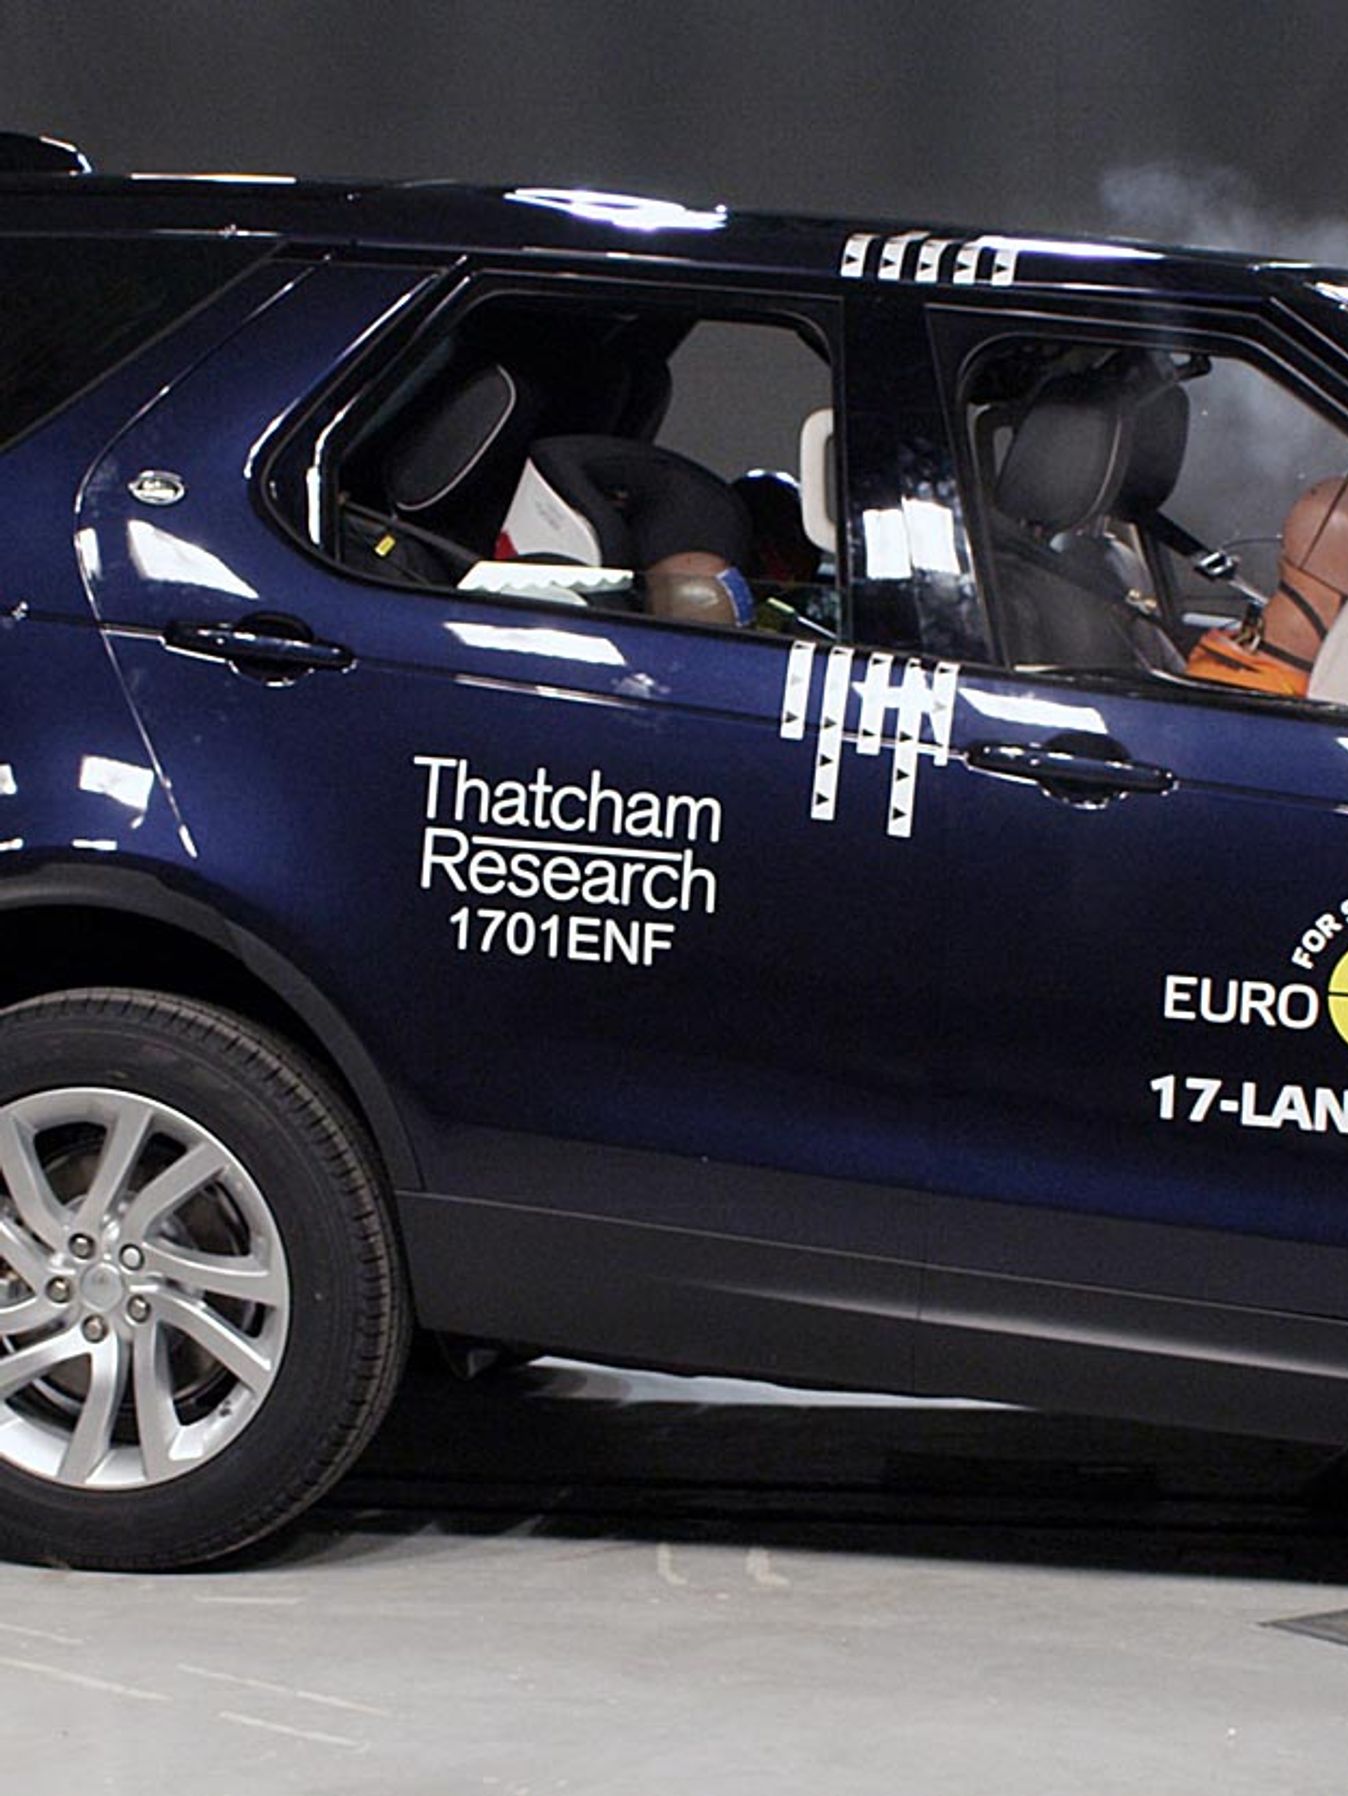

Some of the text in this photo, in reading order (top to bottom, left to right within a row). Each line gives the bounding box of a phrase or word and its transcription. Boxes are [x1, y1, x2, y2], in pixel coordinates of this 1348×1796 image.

[413, 755, 722, 843] Thatcham
[420, 826, 717, 914] Research
[450, 906, 676, 967] 1701ENF
[1291, 913, 1343, 969] FOR
[1164, 974, 1319, 1030] EURO
